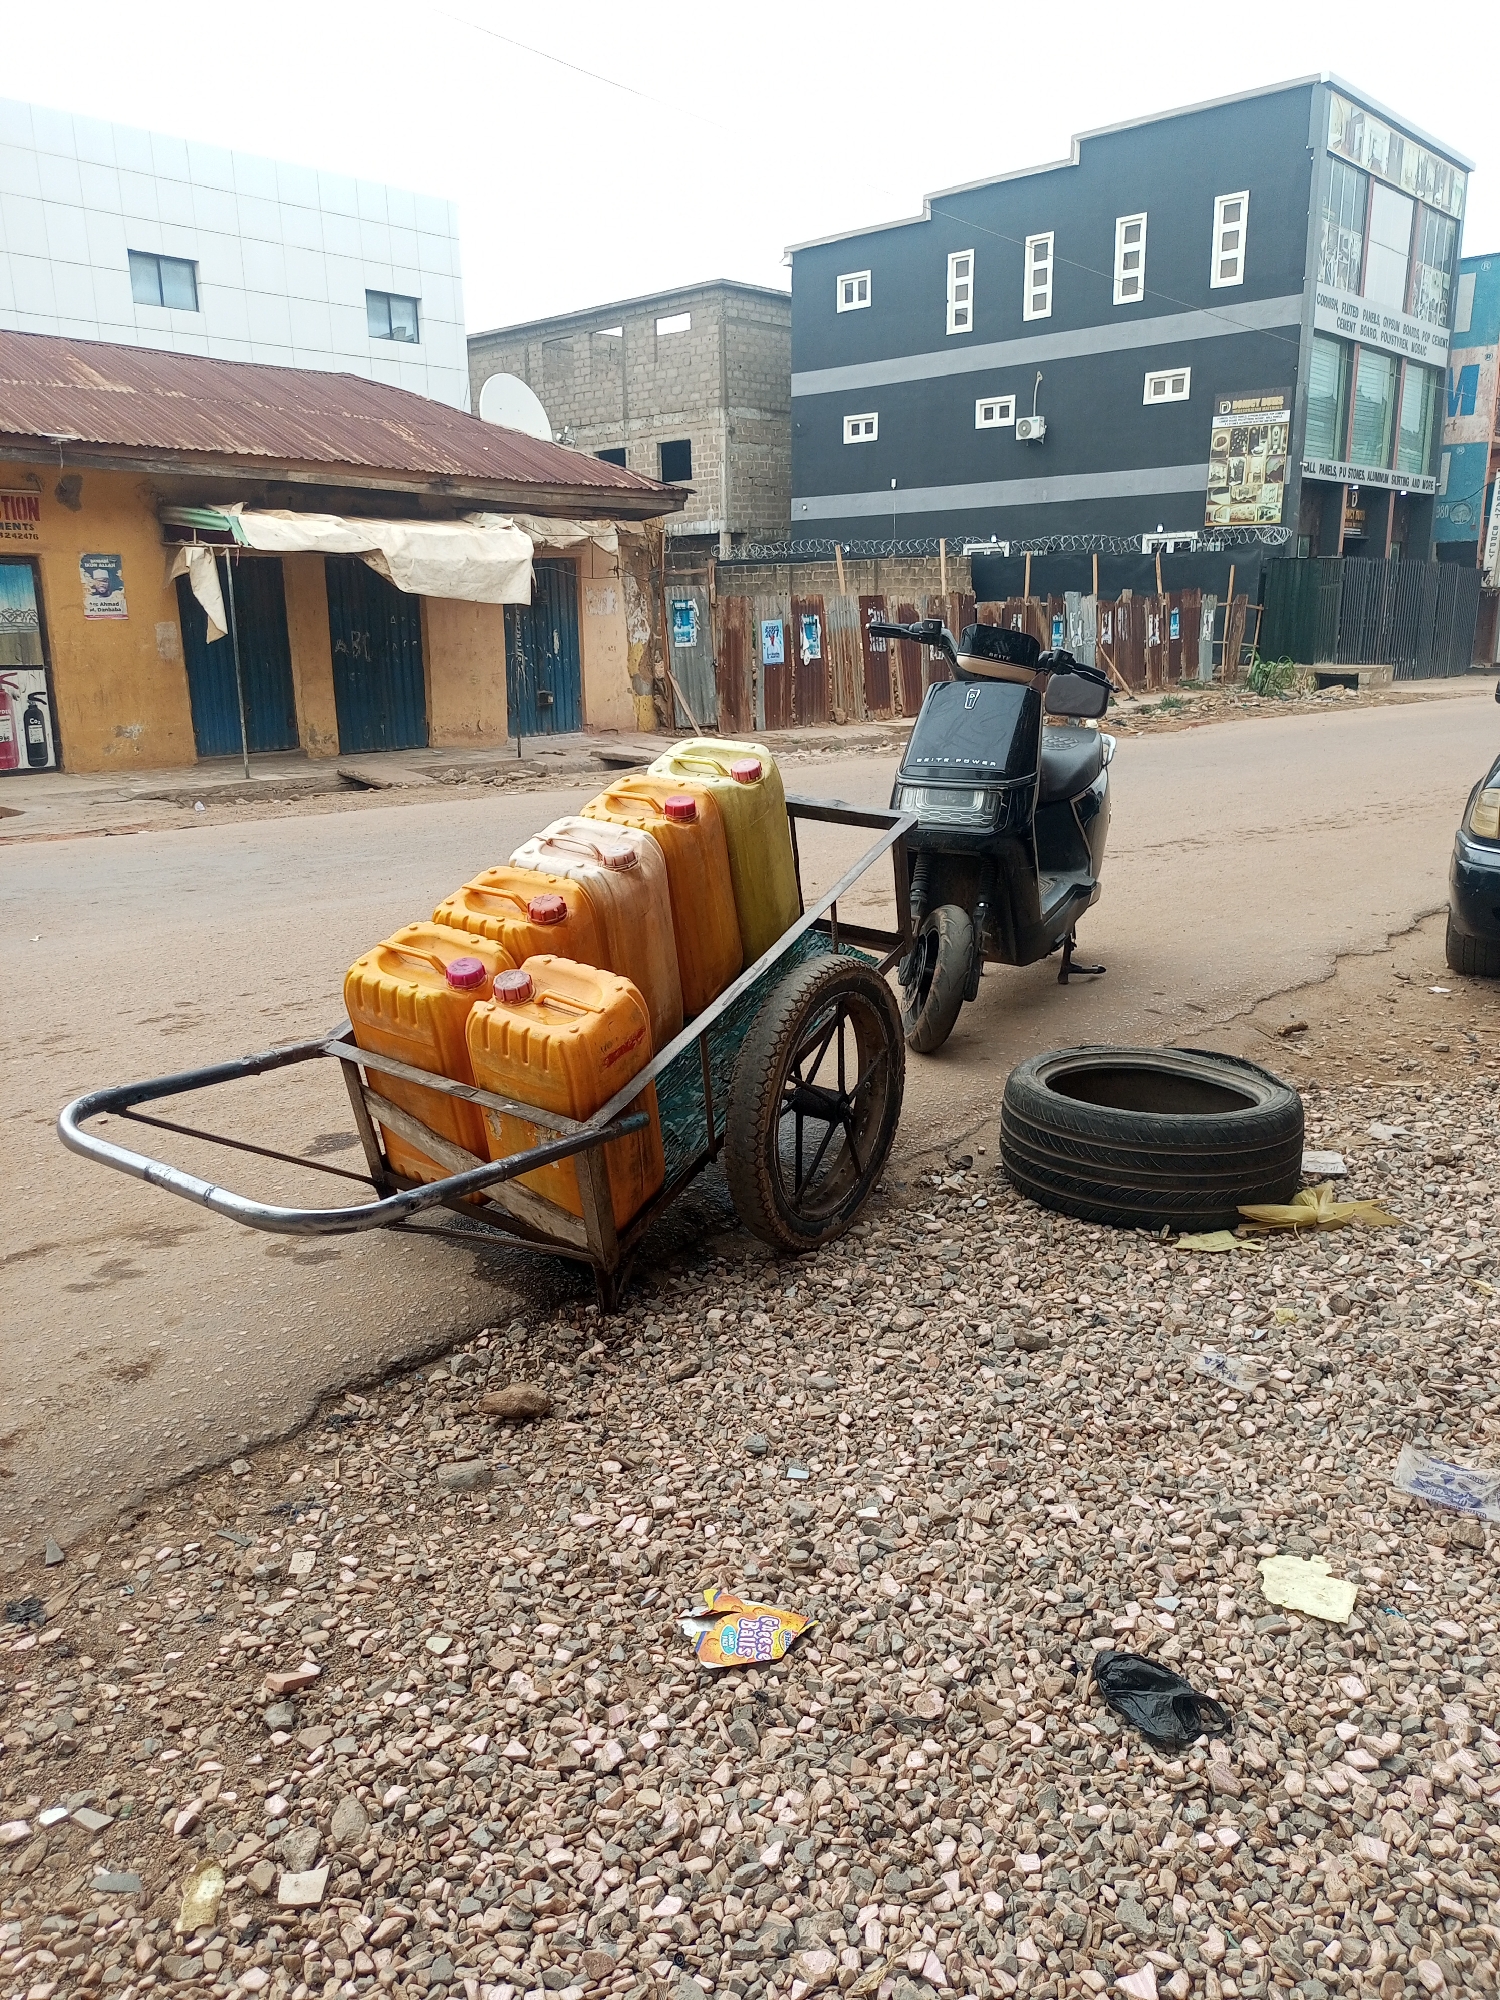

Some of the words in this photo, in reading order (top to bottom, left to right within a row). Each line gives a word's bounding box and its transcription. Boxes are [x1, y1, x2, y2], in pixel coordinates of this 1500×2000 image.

[1336, 317, 1356, 334] CEMENT
[955, 758, 997, 767] POWER
[737, 1618, 760, 1658] Balls
[756, 1616, 780, 1661] Cheese
